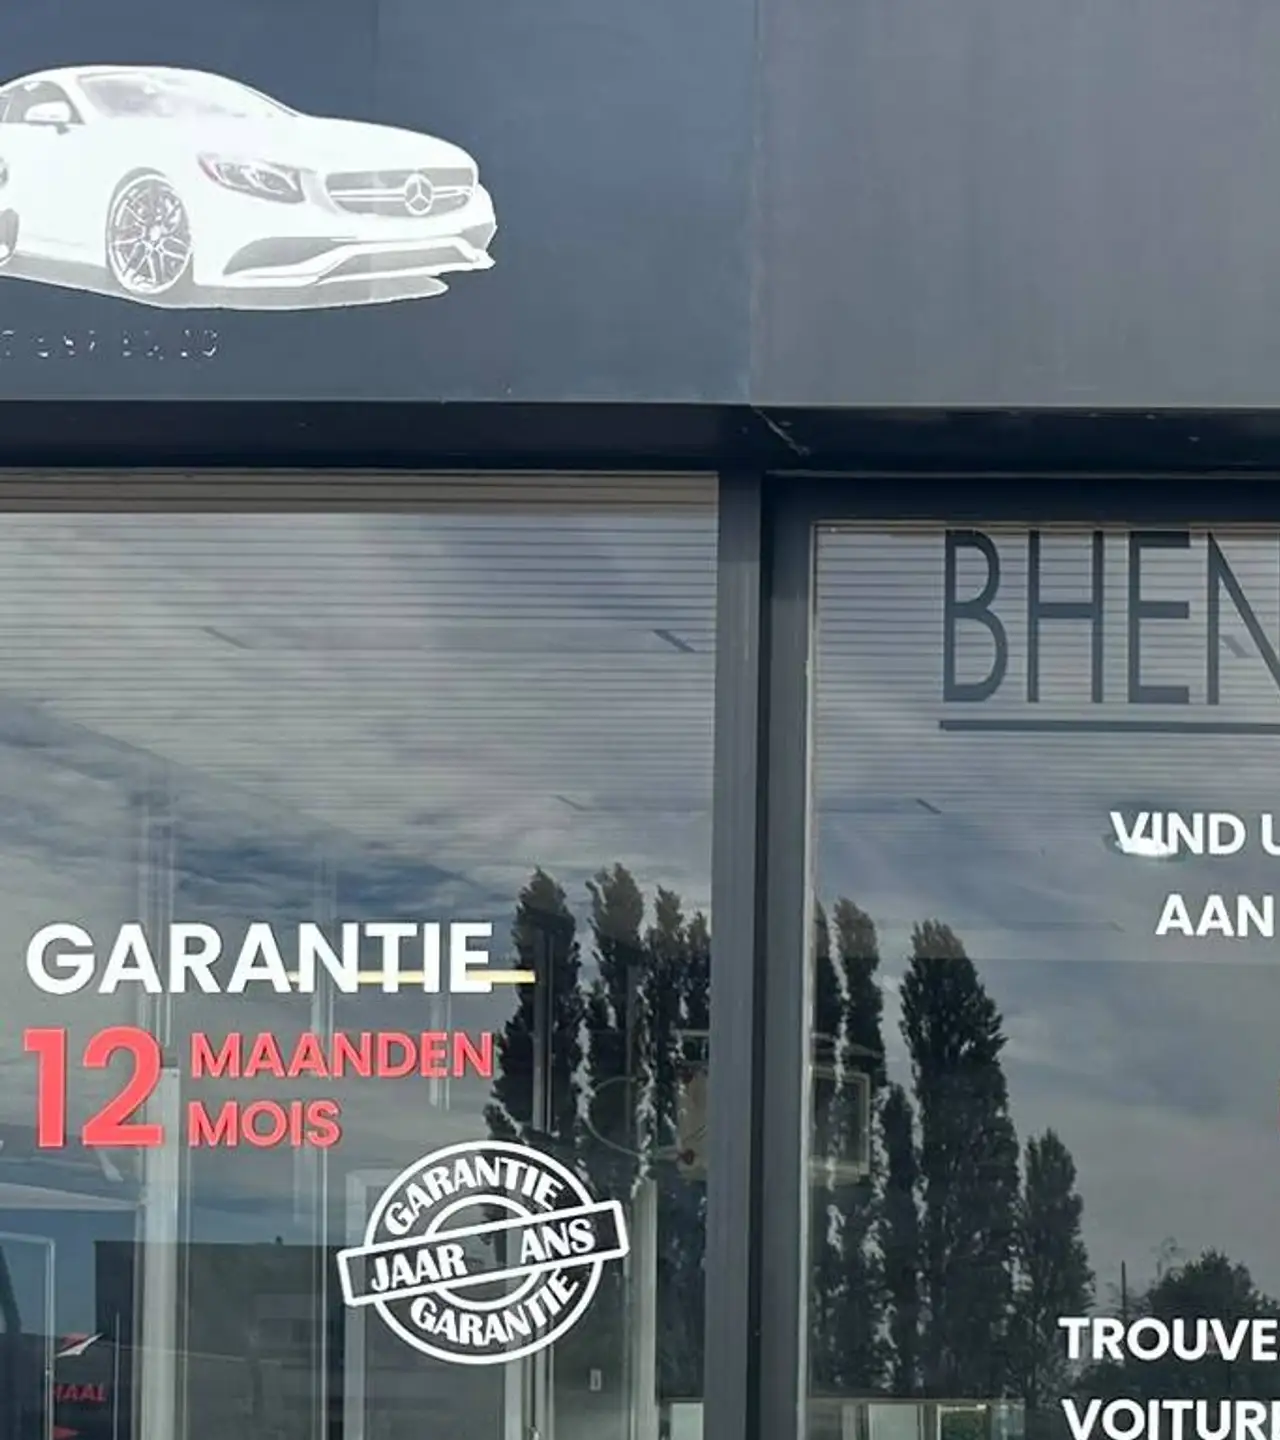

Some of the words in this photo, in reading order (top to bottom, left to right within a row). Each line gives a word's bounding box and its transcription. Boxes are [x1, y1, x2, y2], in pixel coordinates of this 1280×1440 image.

[1109, 811, 1246, 857] VIND
[1154, 893, 1274, 938] AAN
[26, 922, 494, 996] GARANTIE
[22, 1025, 165, 1149] 12
[189, 1031, 494, 1079] MAANDEN
[187, 1101, 342, 1148] MOIS
[383, 1155, 565, 1237] GARANTIE
[370, 1242, 469, 1293] JAAR
[519, 1217, 597, 1266] ANS
[409, 1266, 580, 1347] GARANTIE
